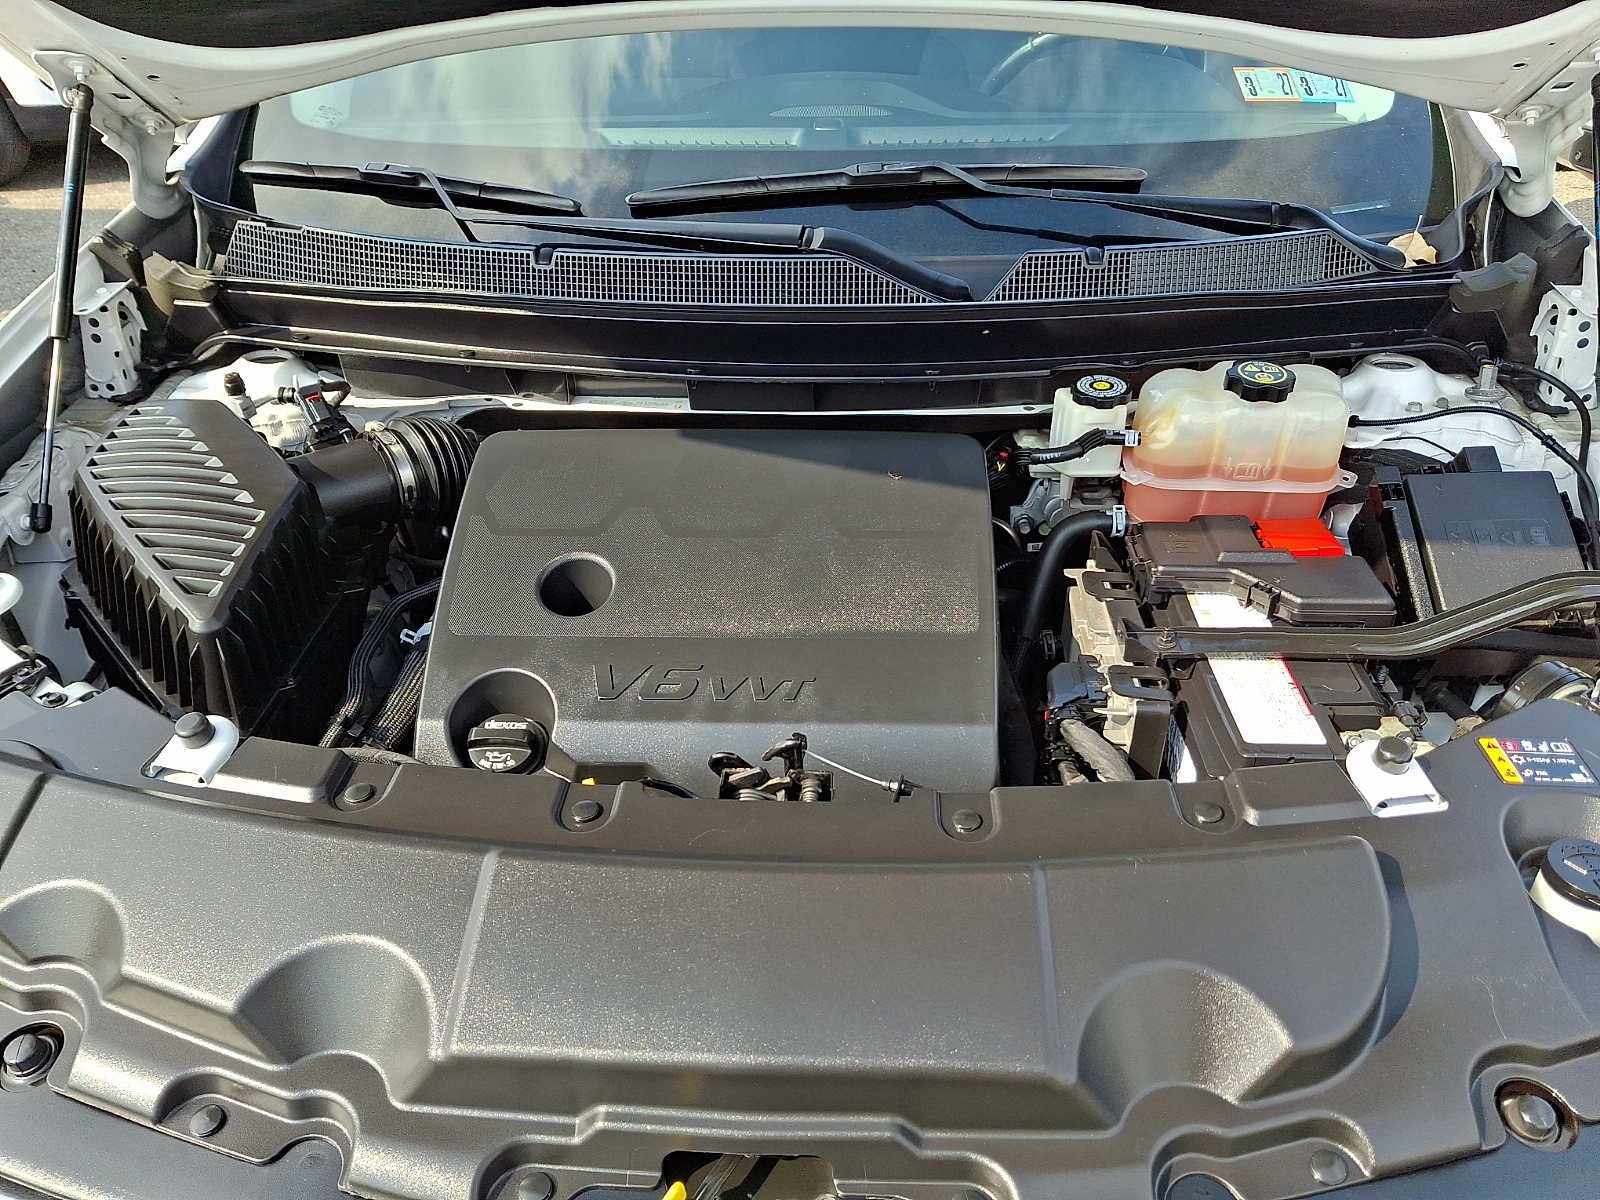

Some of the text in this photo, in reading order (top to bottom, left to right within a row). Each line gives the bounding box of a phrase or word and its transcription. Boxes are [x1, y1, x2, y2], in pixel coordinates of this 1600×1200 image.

[1244, 73, 1294, 97] 3 27
[1300, 76, 1314, 97] 3
[592, 664, 817, 702] V6 VVT
[484, 720, 528, 730] dexos
